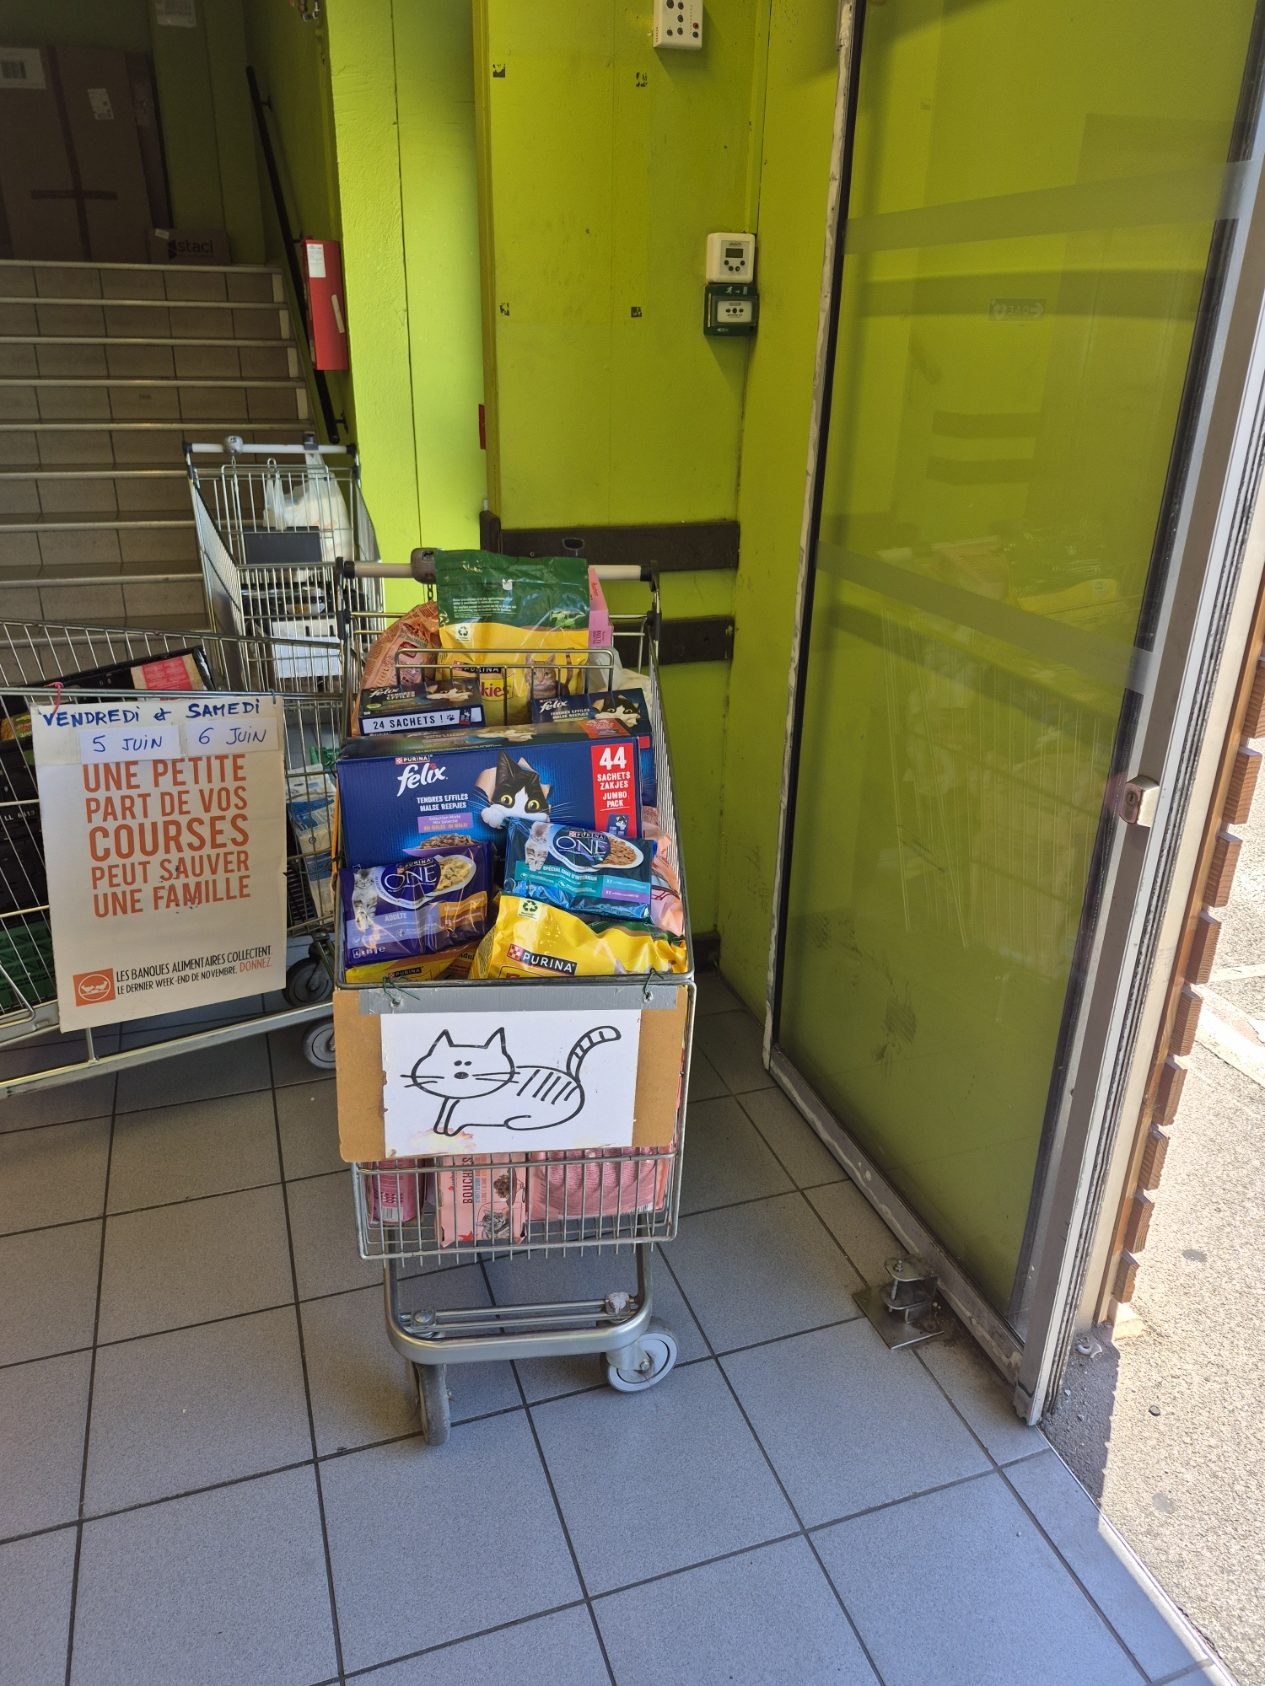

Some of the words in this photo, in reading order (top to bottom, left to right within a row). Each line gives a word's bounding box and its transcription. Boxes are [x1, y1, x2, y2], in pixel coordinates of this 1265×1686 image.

[373, 721, 385, 730] 24
[390, 715, 436, 728] SACHETS
[92, 735, 106, 753] 5
[199, 727, 214, 745] 6
[403, 755, 429, 763] PURINA
[599, 747, 627, 770] 44
[82, 760, 141, 793] UNE
[152, 754, 247, 788] PETITE
[397, 763, 446, 797] felix
[597, 771, 631, 782] SACHETS
[600, 781, 629, 790] ZAKJES
[602, 791, 628, 800] JUMBO
[85, 792, 151, 824] PART
[160, 789, 191, 817] DE
[199, 785, 248, 814] VOS
[606, 799, 624, 808] PACK
[89, 813, 250, 862] COURSES
[556, 835, 608, 854] ONE
[91, 860, 152, 890] PEUT
[159, 850, 250, 883] SAUVER
[384, 863, 437, 890] ONE
[93, 888, 144, 918] UNE
[152, 874, 251, 911] FAMILLE
[116, 970, 130, 983] LES
[131, 963, 170, 981] BANQUES
[171, 953, 226, 972] ALIMENTAIRES
[226, 945, 272, 963] COLLECTENT
[522, 952, 573, 974] PURINA
[117, 984, 125, 995] LE
[126, 980, 154, 994] DERNIER
[191, 973, 200, 982] DE
